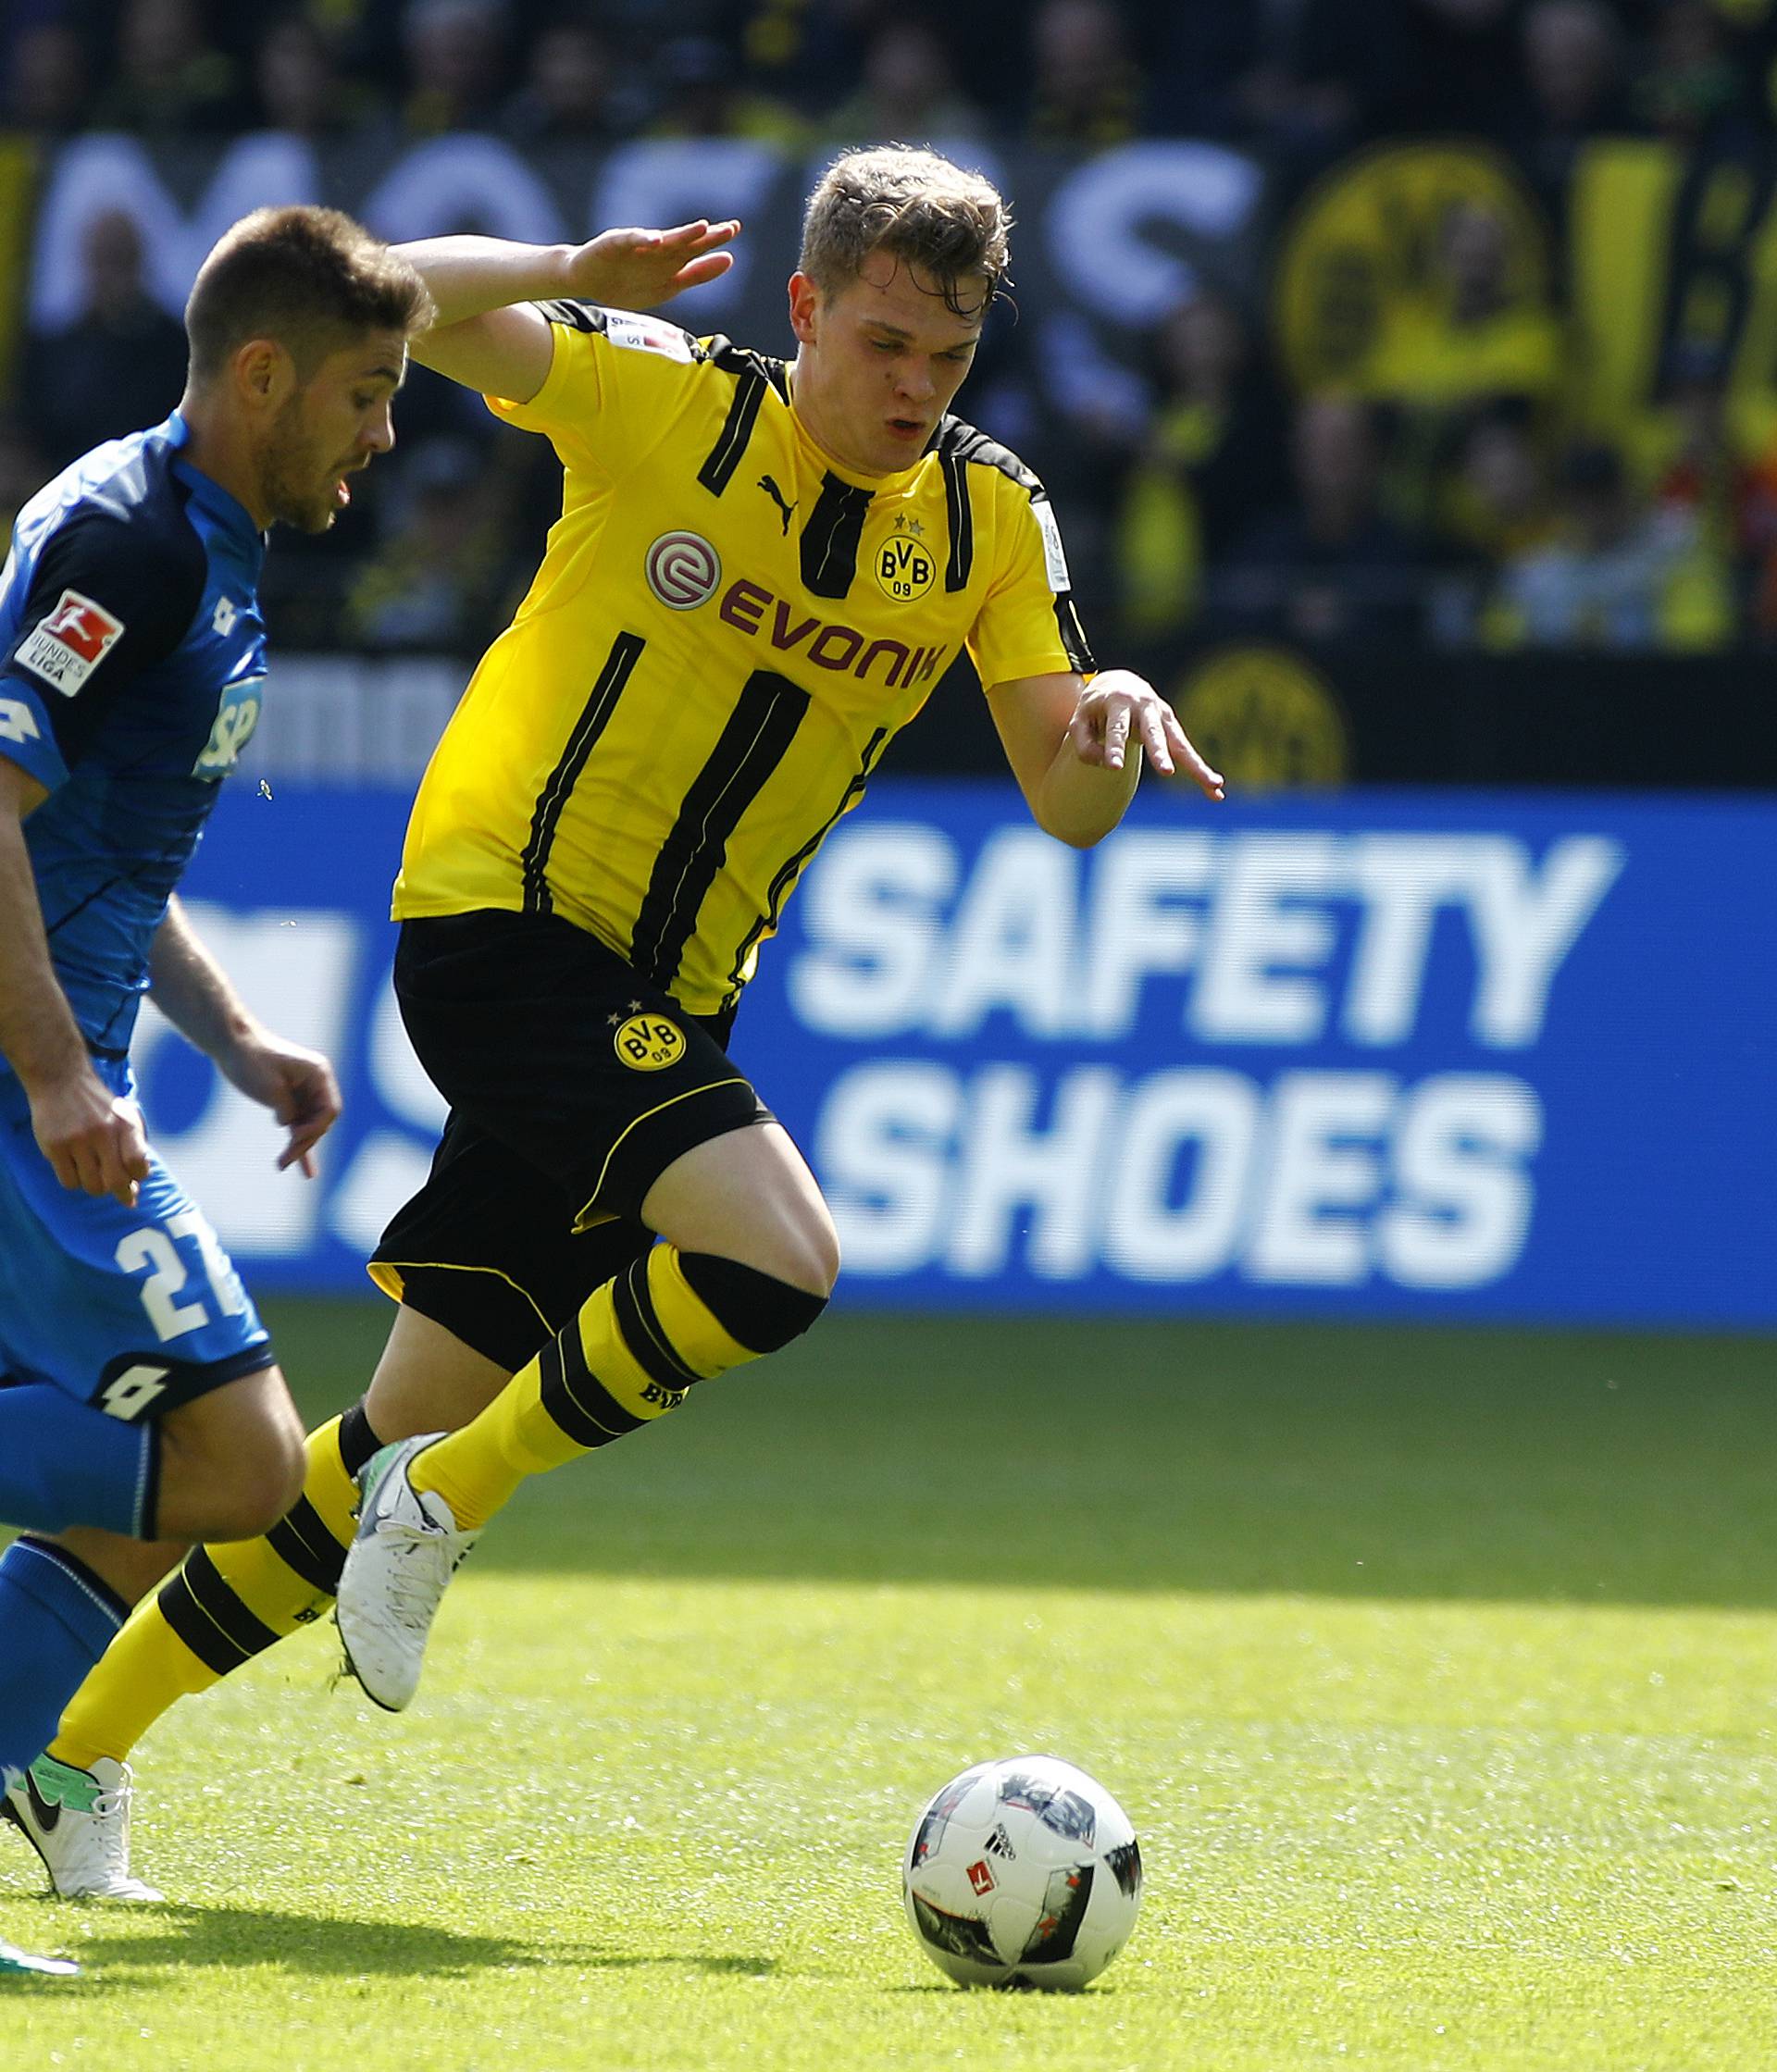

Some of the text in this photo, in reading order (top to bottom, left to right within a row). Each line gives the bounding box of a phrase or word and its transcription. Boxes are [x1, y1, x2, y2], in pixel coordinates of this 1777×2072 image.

[882, 540, 928, 584] BVB
[893, 581, 911, 596] 09
[719, 578, 947, 689] EVONIK
[29, 650, 65, 681] LIGA
[786, 820, 1627, 1048] SAFETY
[623, 1020, 677, 1061] BVB
[652, 1047, 672, 1062] 09
[813, 1056, 1546, 1292] SHOES
